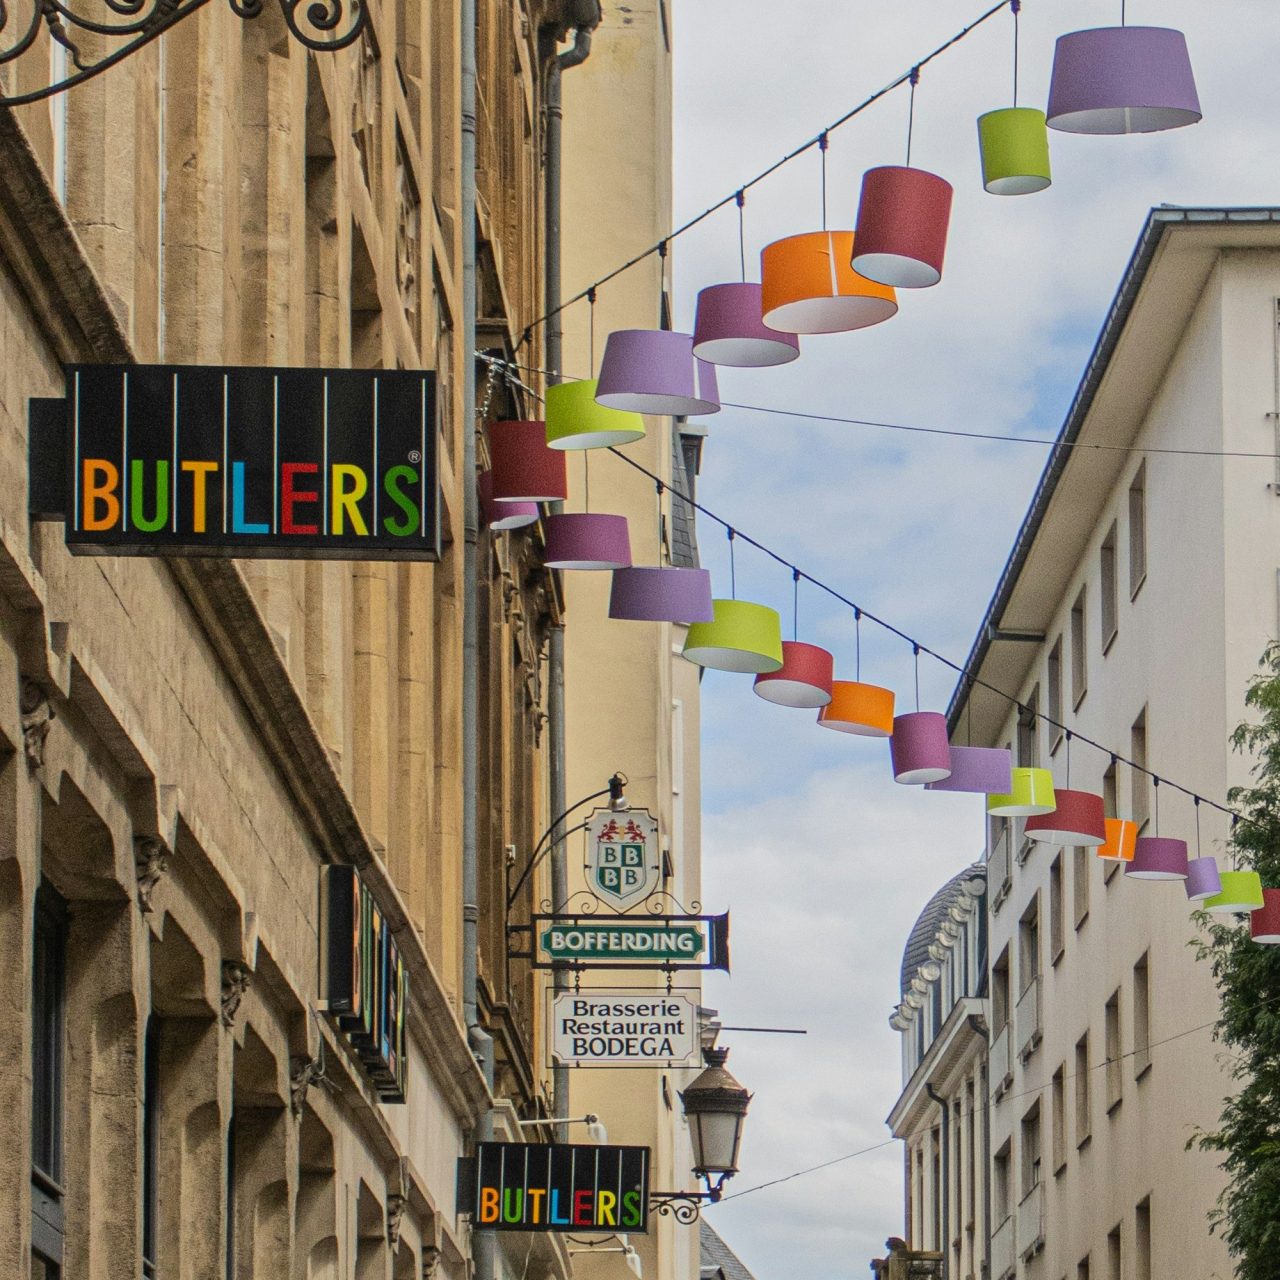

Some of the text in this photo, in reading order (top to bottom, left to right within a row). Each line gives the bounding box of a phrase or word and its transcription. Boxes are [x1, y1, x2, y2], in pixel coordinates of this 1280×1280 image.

[83, 459, 420, 537] BUTLERS
[551, 931, 694, 952] BOFFERDING
[573, 1000, 681, 1017] Brasserie
[562, 1019, 685, 1035] Restaurant
[573, 1037, 674, 1057] BODEGA
[480, 1187, 640, 1226] BUTLERS
